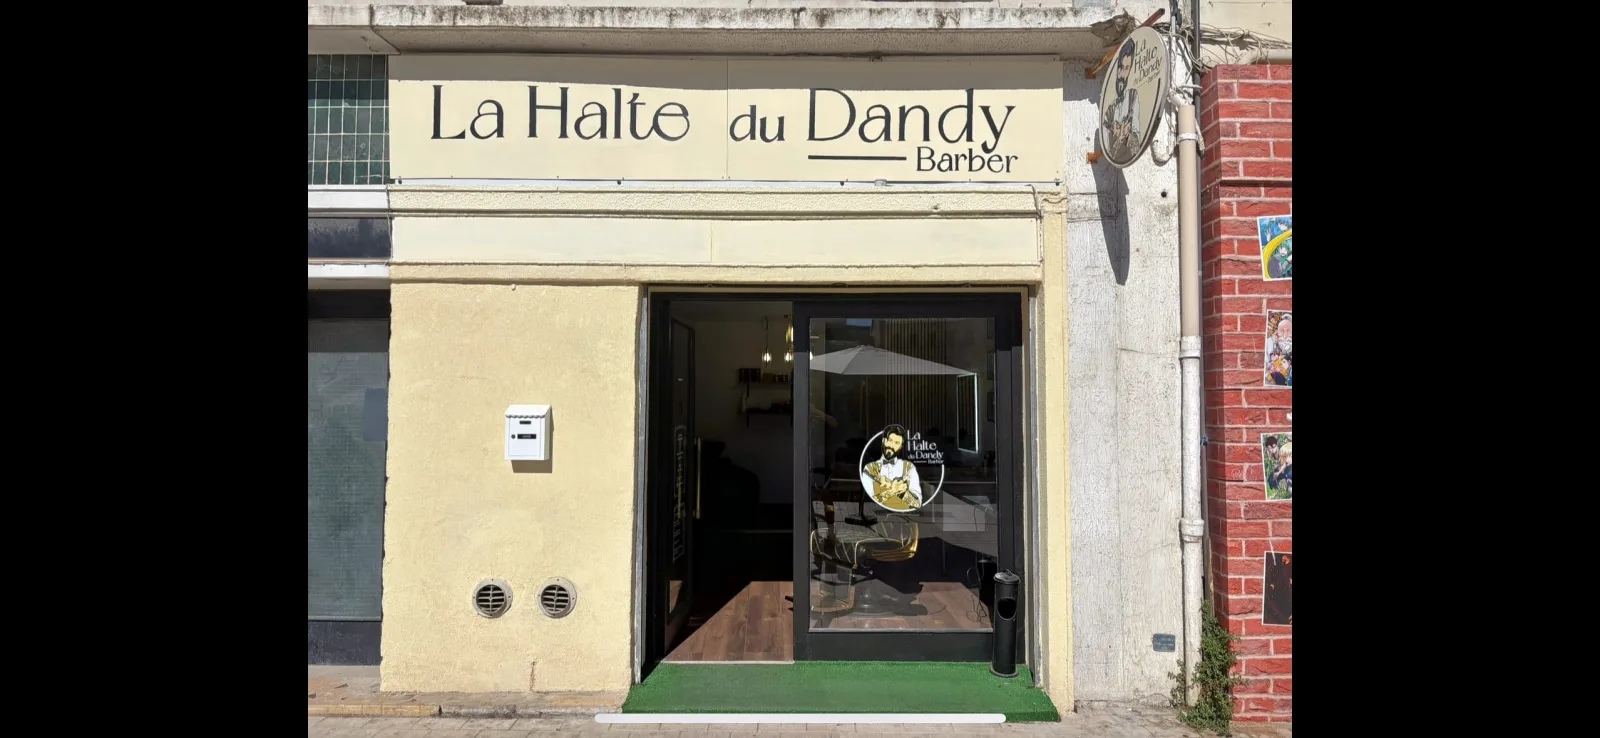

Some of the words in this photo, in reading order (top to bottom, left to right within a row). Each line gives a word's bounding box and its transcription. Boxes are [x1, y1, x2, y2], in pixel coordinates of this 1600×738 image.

[1135, 39, 1147, 57] La
[1134, 46, 1158, 74] Halte
[431, 85, 504, 140] La
[528, 85, 691, 141] Halte
[729, 105, 785, 142] du
[806, 87, 1015, 155] Dandy
[916, 147, 1019, 173] Barber
[907, 429, 921, 440] La
[907, 440, 937, 451] Halte
[915, 450, 944, 460] Dandy
